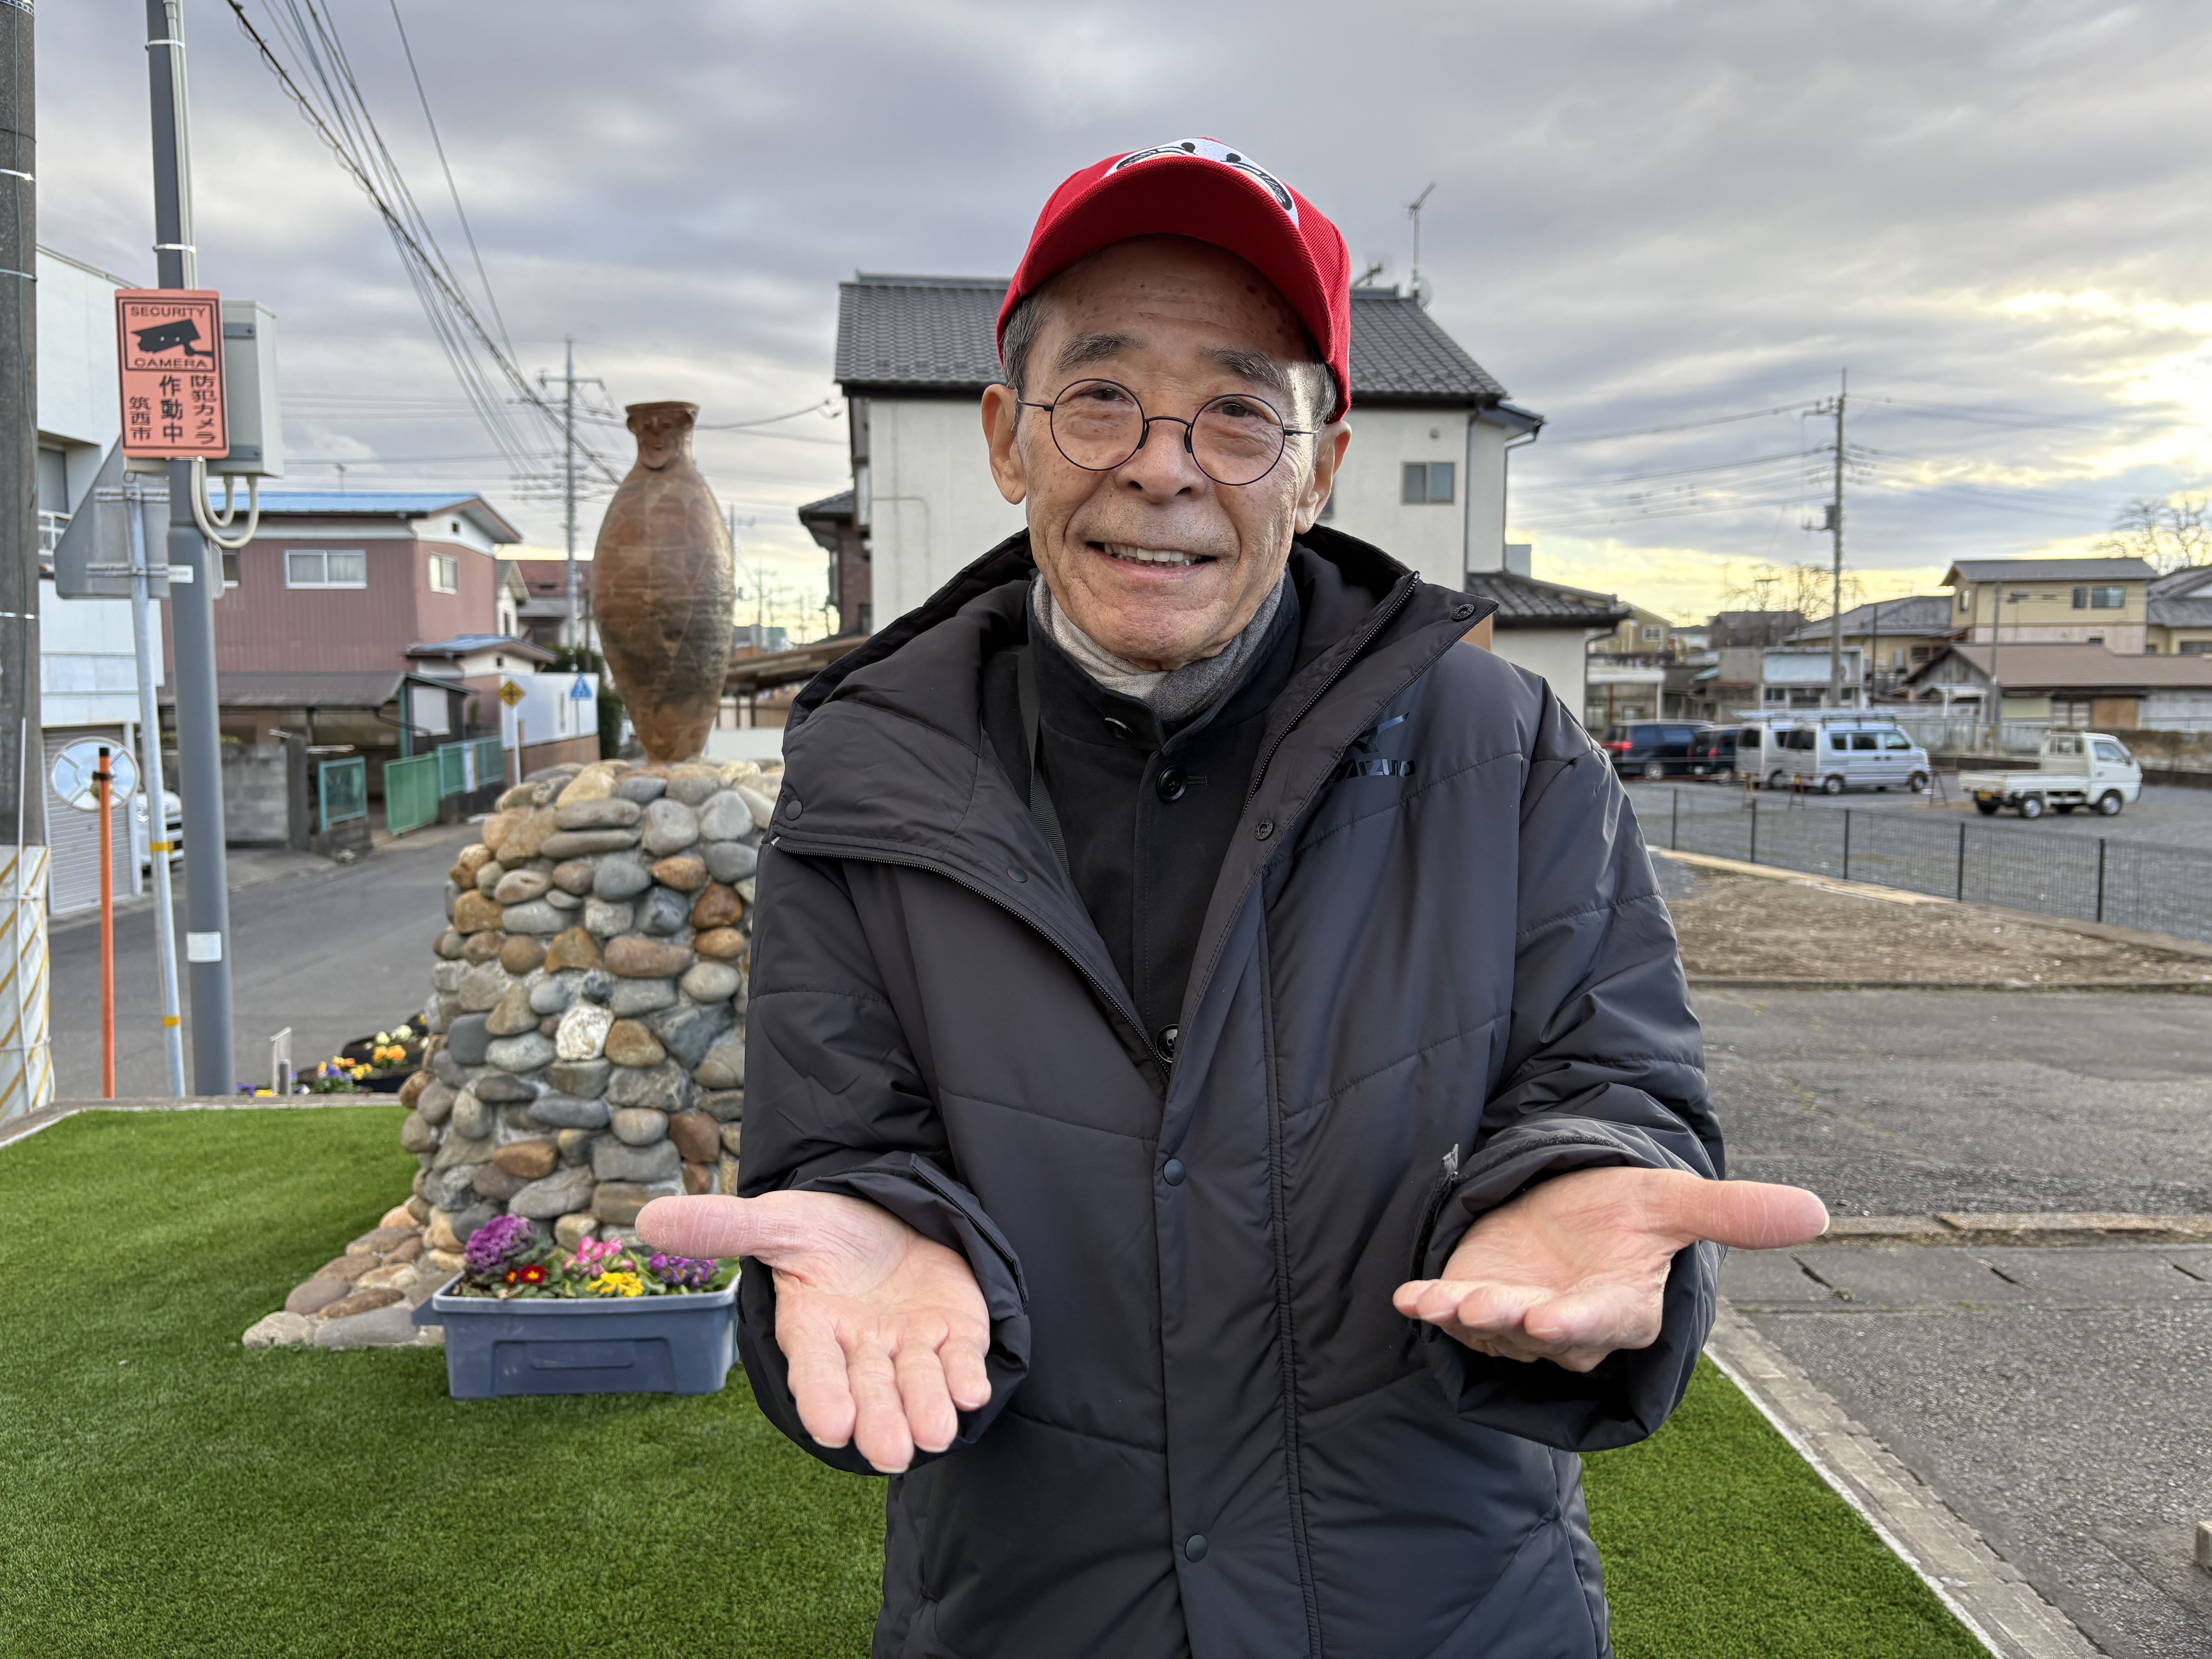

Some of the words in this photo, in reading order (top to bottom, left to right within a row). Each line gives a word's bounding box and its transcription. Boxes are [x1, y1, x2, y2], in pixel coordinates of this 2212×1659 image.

[131, 306, 205, 318] SECURITY
[134, 358, 207, 367] CAMERA
[129, 395, 151, 441] 筑西市
[159, 374, 183, 444] 作動中
[191, 374, 217, 444] 防犯カメラ
